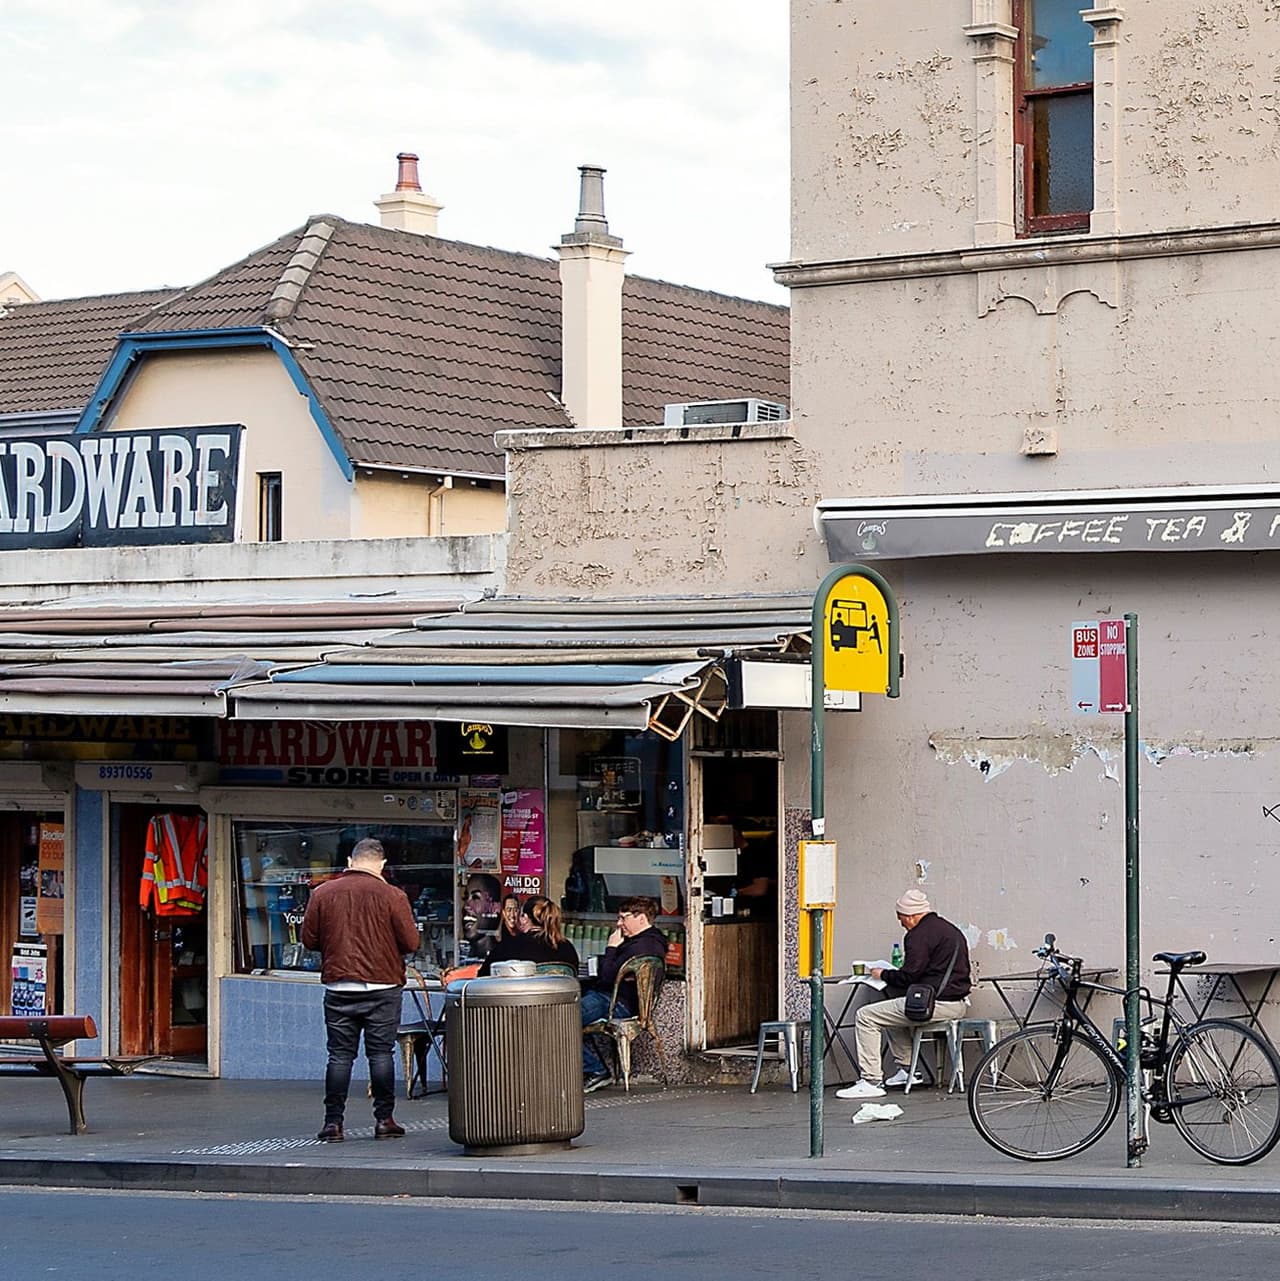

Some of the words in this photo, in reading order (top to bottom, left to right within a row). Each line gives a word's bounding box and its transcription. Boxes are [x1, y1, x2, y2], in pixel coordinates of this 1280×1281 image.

[985, 515, 1128, 547] COFFEE
[1146, 516, 1206, 543] TEA
[1220, 511, 1251, 543] &
[1076, 630, 1097, 643] BUS
[1107, 625, 1118, 640] NO
[1077, 644, 1096, 656] ZONE
[218, 721, 438, 767] HARDWAR
[99, 765, 153, 780] 89370556
[288, 767, 390, 785] STORE
[393, 771, 423, 783] OPEN
[524, 876, 541, 888] DO
